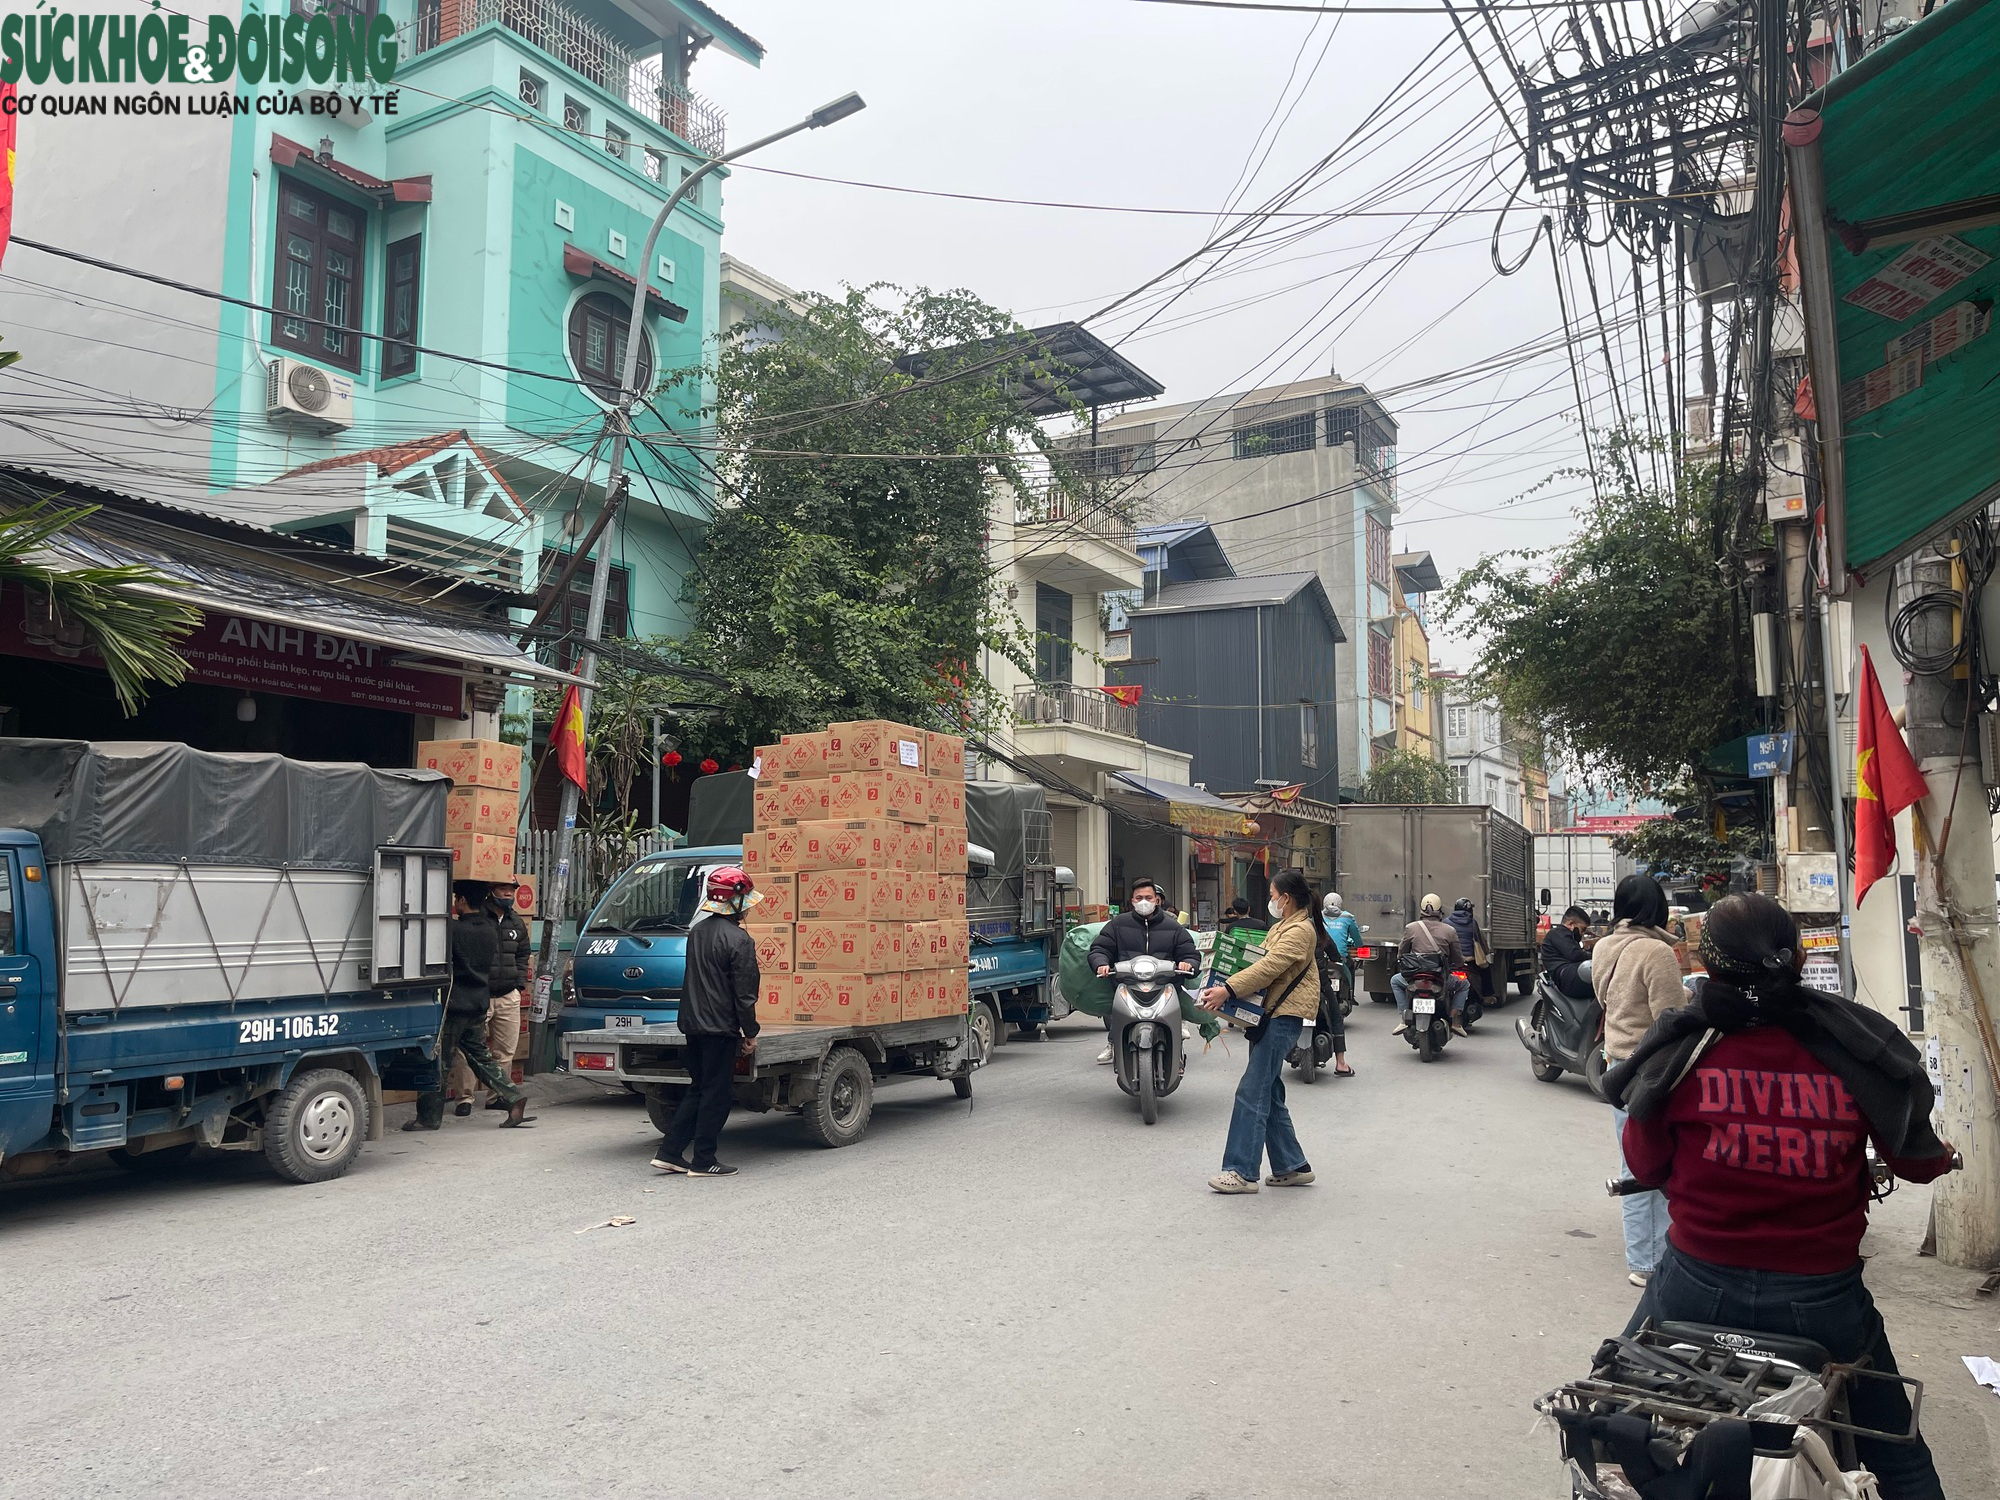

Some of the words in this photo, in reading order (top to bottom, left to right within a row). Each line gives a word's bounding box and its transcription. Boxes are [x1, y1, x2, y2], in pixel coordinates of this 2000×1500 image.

[220, 618, 304, 656] ANH
[314, 634, 381, 670] ĐẠT
[202, 669, 220, 678] KCN
[208, 652, 234, 664] phân
[236, 656, 261, 668] phối:
[264, 660, 288, 672] bánh
[290, 664, 310, 676] kẹo,
[312, 670, 334, 680] rượu
[336, 671, 353, 683] bia,
[354, 676, 376, 686] nước
[378, 678, 394, 689] giải
[794, 747, 807, 759] An
[840, 786, 852, 800] An
[767, 800, 779, 812] An
[792, 794, 806, 806] An
[779, 840, 793, 852] An
[814, 885, 828, 898] An
[586, 940, 619, 955] 24/24
[810, 937, 826, 949] An
[626, 969, 640, 977] KIA
[807, 988, 822, 1000] An
[615, 1017, 632, 1027] 29H
[239, 1014, 339, 1044] 29H-106.52
[1696, 1068, 1858, 1120] DIVINE
[1703, 1123, 1856, 1178] MERIT
